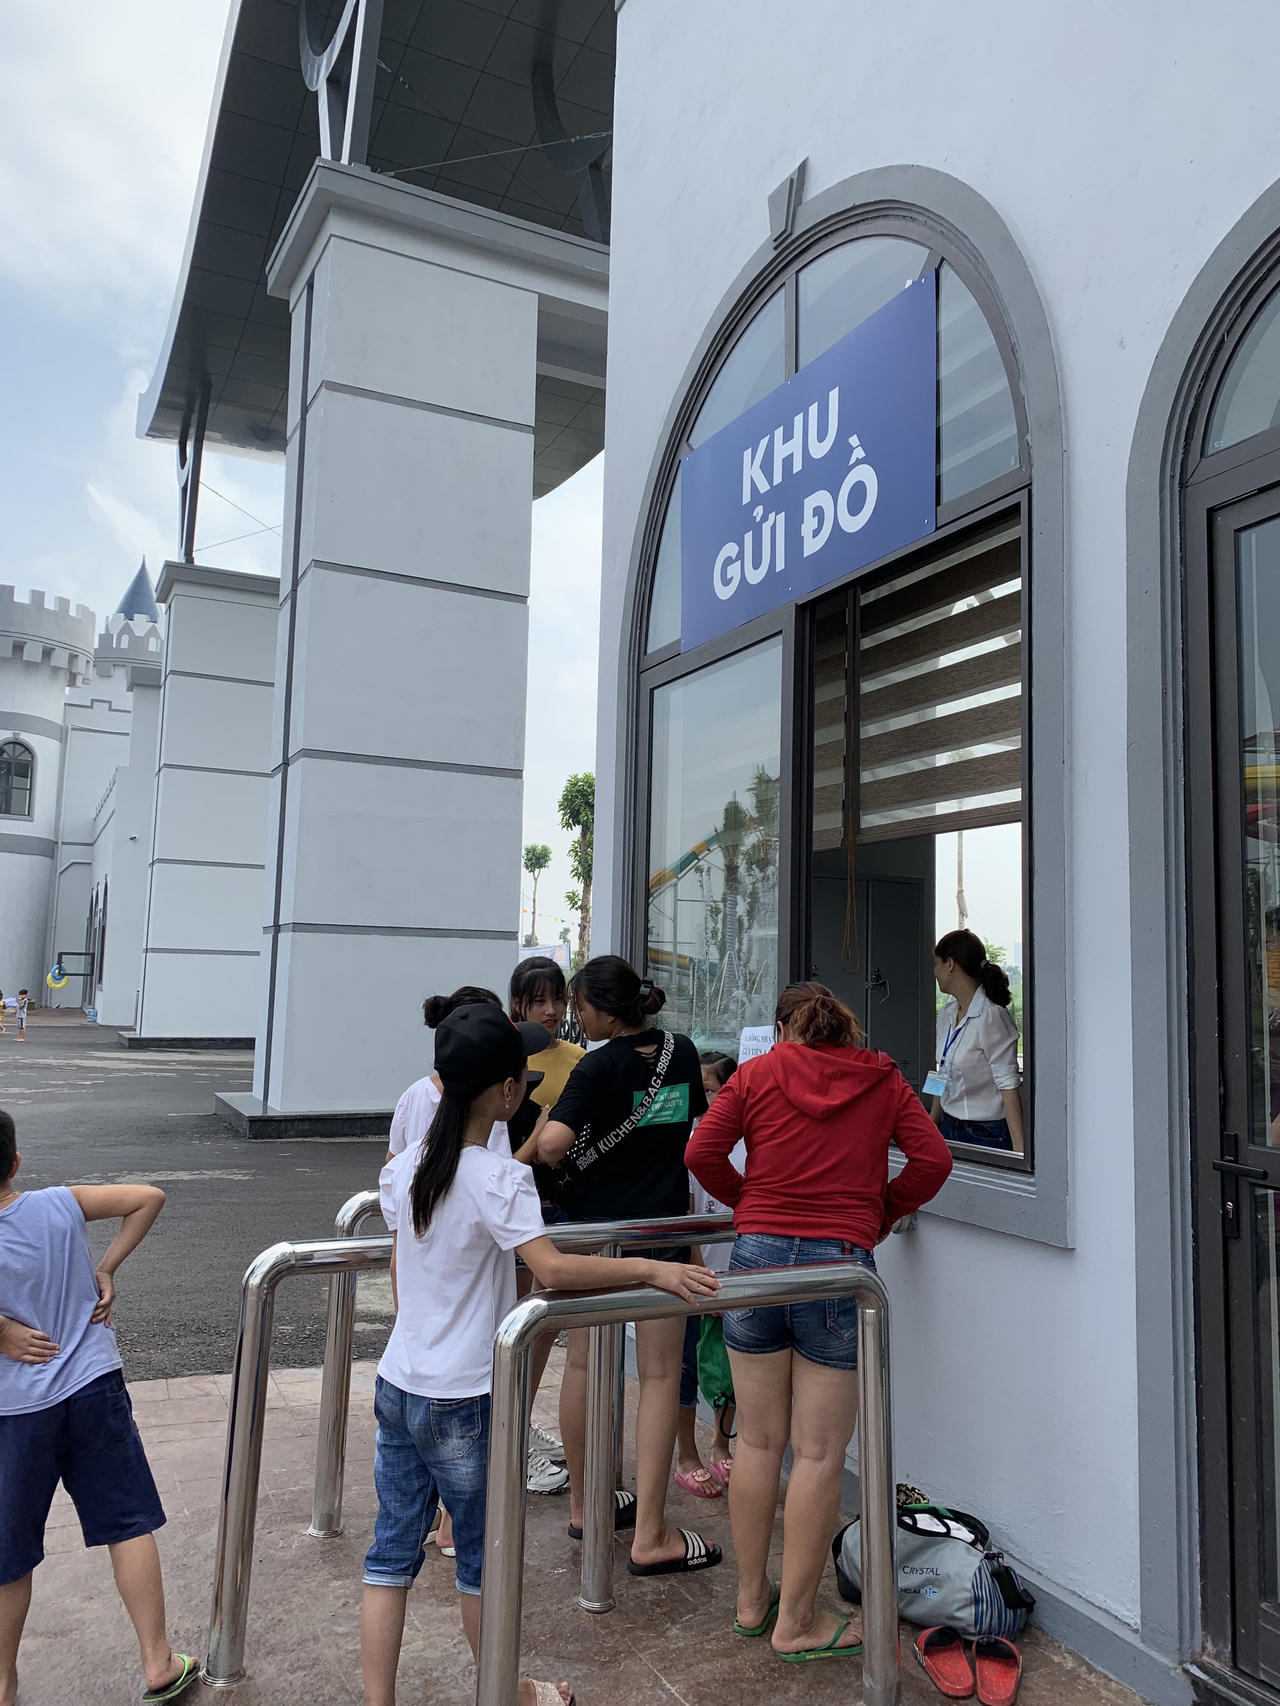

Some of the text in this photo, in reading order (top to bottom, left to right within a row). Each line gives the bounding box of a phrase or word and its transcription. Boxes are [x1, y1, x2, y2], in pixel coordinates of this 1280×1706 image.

[742, 386, 839, 505] KHU
[713, 434, 878, 600] GỬI ĐỒ
[902, 1565, 941, 1576] CRYSTAL
